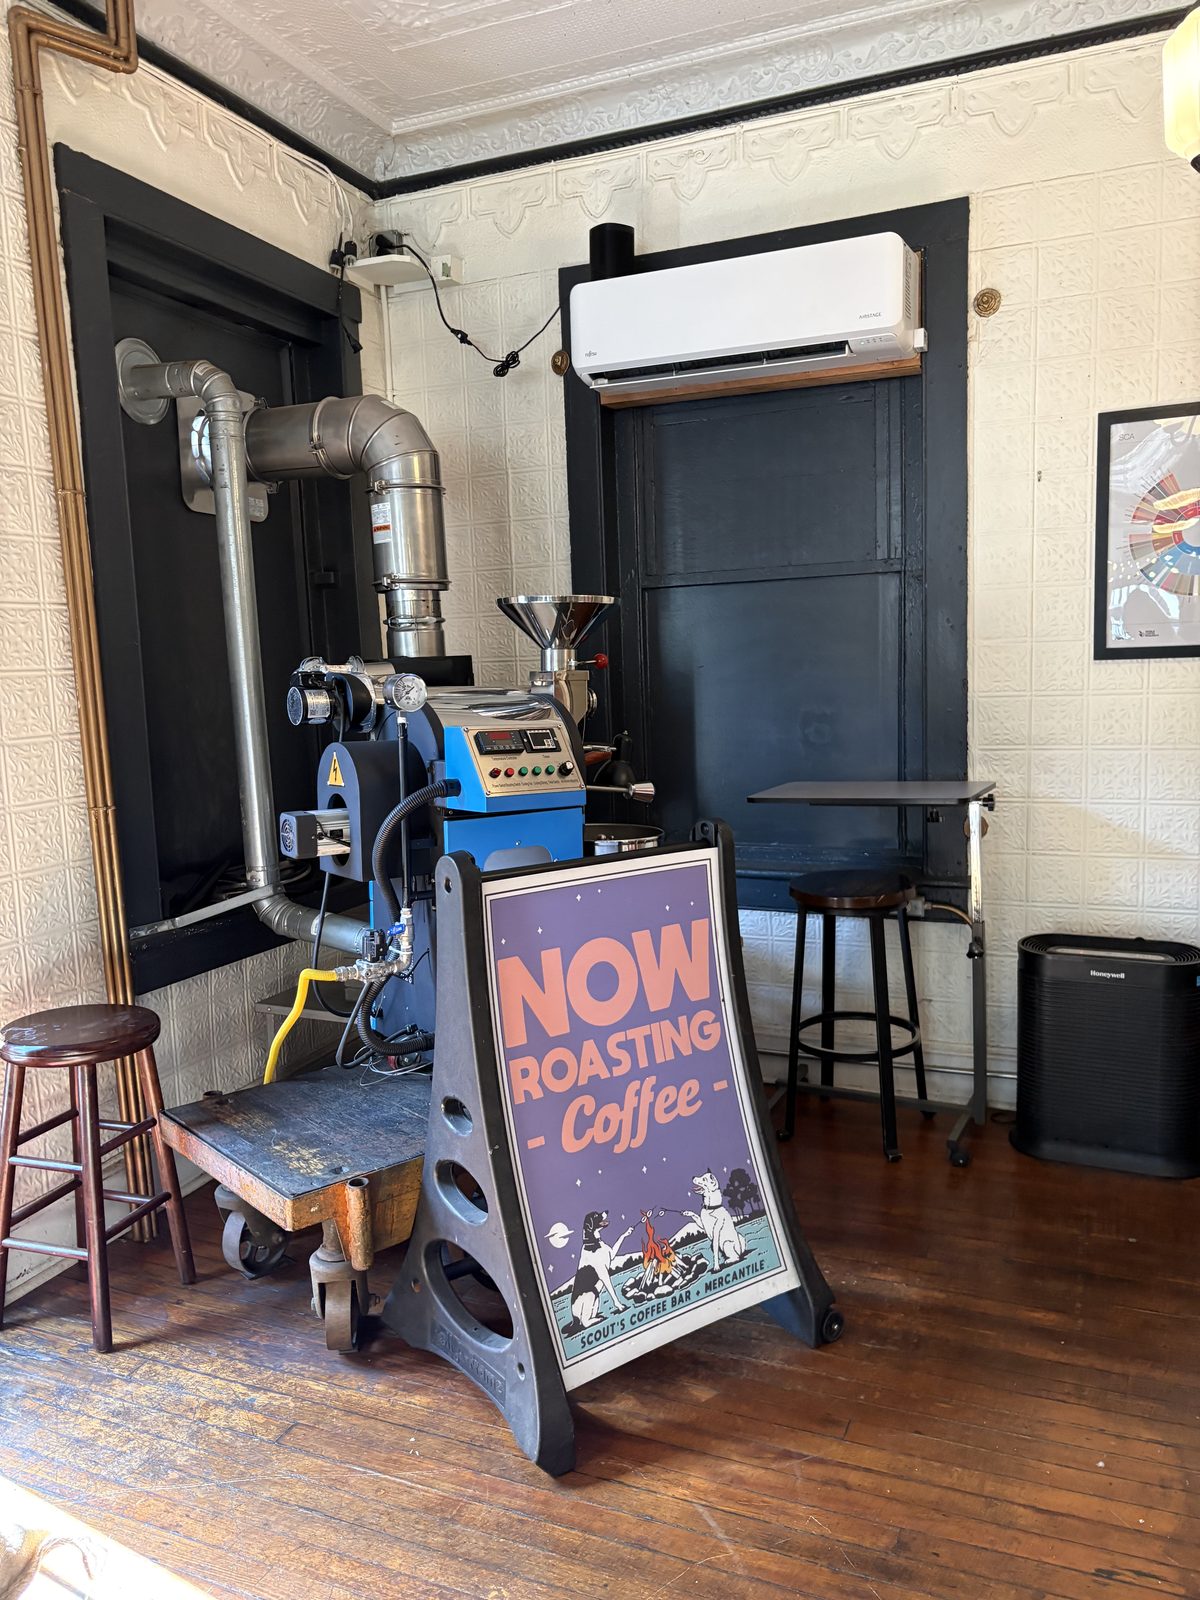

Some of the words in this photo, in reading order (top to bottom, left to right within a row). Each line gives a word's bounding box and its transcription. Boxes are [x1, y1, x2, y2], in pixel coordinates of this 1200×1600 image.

[497, 917, 710, 1049] NOW
[1090, 969, 1125, 979] Honeywell
[509, 1009, 721, 1105] ROASTING
[561, 1076, 703, 1153] Coffee
[580, 1319, 626, 1349] SCOUT'S
[629, 1300, 667, 1326] COFFEE
[671, 1290, 691, 1308] BAR
[704, 1259, 765, 1294] MERCANTILE
